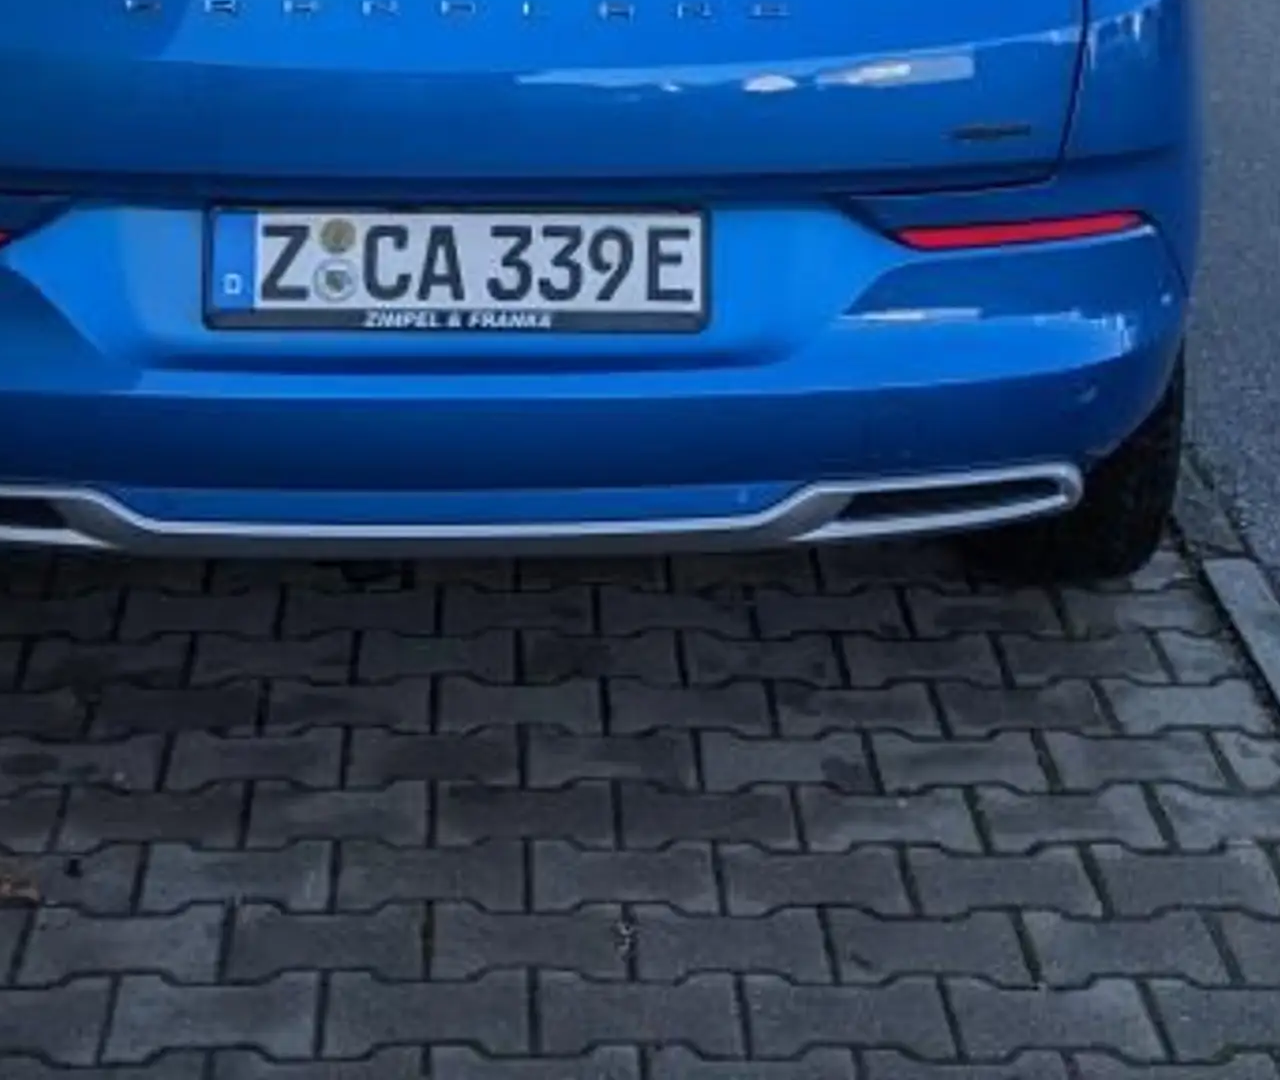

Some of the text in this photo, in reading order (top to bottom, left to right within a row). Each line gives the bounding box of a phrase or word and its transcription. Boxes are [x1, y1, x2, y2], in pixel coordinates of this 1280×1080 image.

[261, 225, 693, 302] Z CA 339E
[364, 309, 441, 328] ZIMPEL
